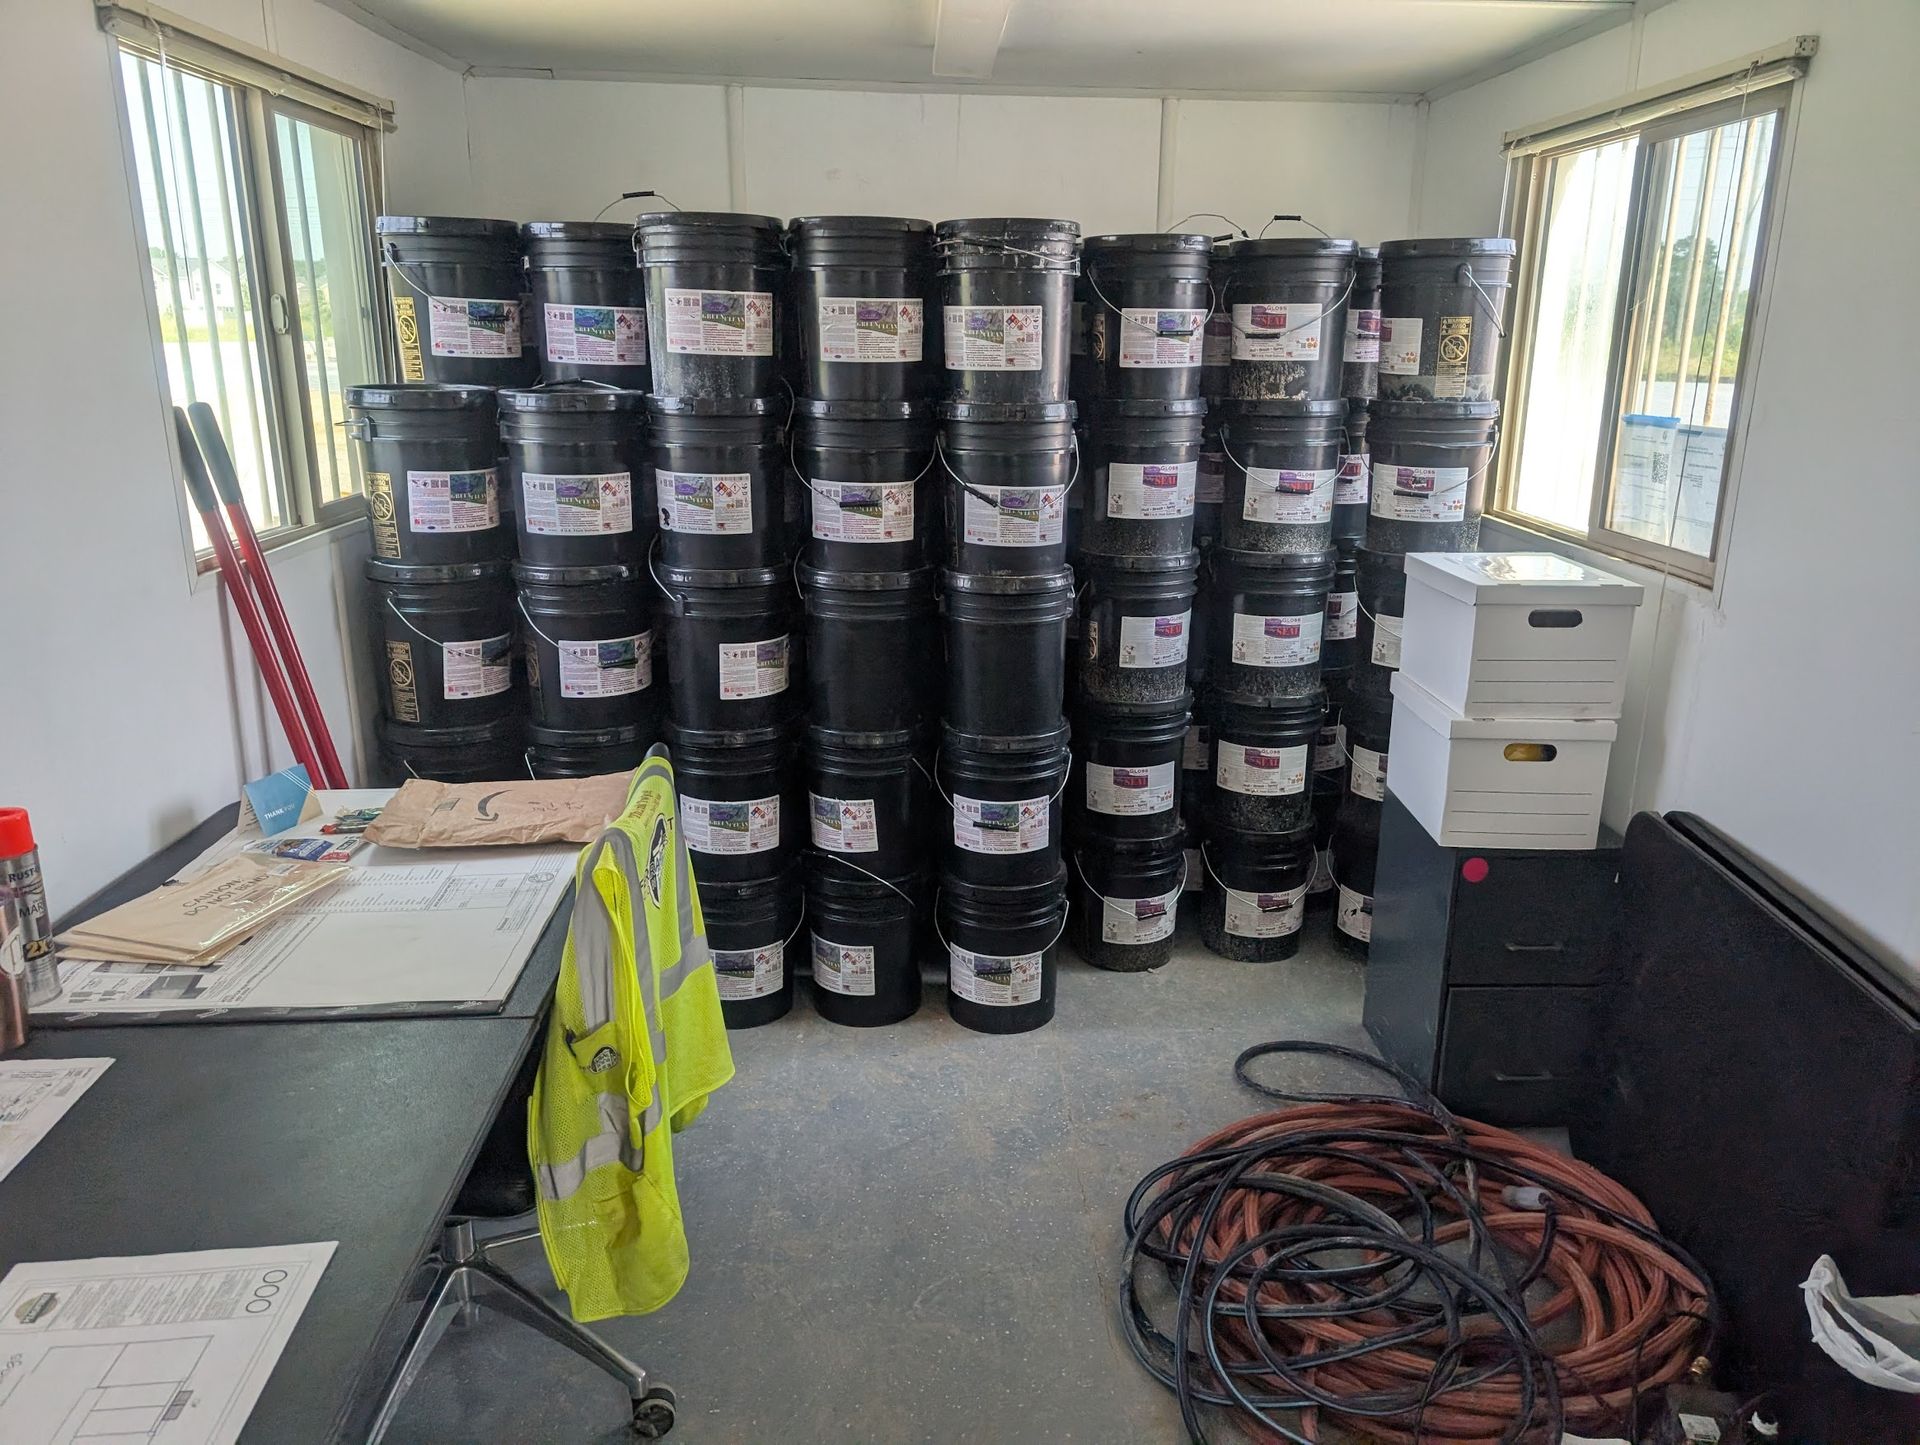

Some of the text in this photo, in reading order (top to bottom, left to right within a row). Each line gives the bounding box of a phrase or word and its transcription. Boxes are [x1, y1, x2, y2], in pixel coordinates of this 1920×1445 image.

[264, 808, 284, 820] THANK
[183, 905, 208, 916] DO
[207, 891, 236, 905] NOT
